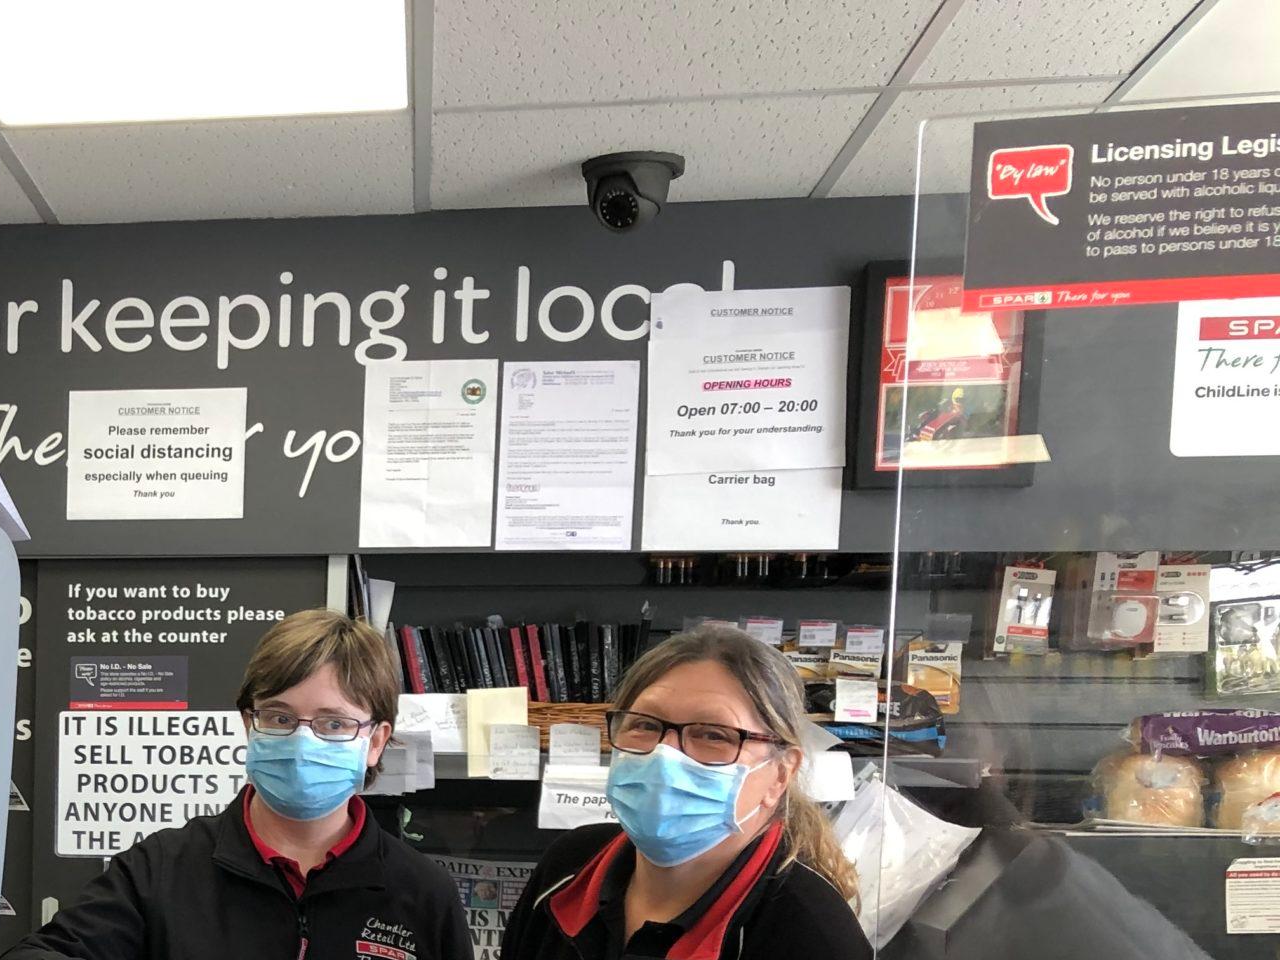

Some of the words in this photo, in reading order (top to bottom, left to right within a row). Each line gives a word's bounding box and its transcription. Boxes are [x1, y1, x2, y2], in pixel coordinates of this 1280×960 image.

[1092, 139, 1213, 163] Licensing
[1090, 176, 1111, 188] No
[1115, 174, 1163, 188] person
[1167, 171, 1206, 183] under
[1089, 191, 1107, 203] be
[1112, 188, 1157, 202] served
[1161, 186, 1189, 198] with
[1194, 183, 1254, 197] alcoholic
[1088, 214, 1111, 226] We
[1115, 212, 1165, 224] reserve
[1169, 210, 1191, 221] the
[1195, 207, 1225, 222] right
[1104, 227, 1153, 240] alcohol
[1169, 226, 1190, 237] we
[1086, 245, 1100, 257] to
[1103, 245, 1137, 259] pass
[1141, 242, 1155, 254] to
[1158, 239, 1215, 255] persons
[1219, 237, 1260, 250] under
[61, 271, 408, 369] keeping
[432, 265, 490, 345] it
[710, 308, 759, 317] CUSTOMER
[761, 307, 794, 316] NOTICE
[703, 353, 757, 364] CUSTOMER
[760, 351, 796, 361] NOTICE
[1198, 347, 1264, 371] There
[703, 380, 751, 390] OPENING
[753, 378, 792, 388] HOURS
[1195, 385, 1270, 398] ChildLine
[118, 407, 166, 415] CUSTOMER
[677, 403, 716, 420] Open
[721, 402, 761, 415] 07:00
[778, 399, 818, 413] 20:00
[108, 425, 146, 435] Please
[150, 425, 210, 435] remember
[83, 444, 135, 459] social
[141, 444, 233, 461] distancing
[85, 471, 142, 483] especially
[146, 471, 177, 481] when
[181, 470, 228, 483] queuing
[708, 474, 750, 486] Carrier
[753, 474, 776, 486] bag
[721, 518, 740, 526] Thank
[68, 584, 82, 598] If
[86, 586, 118, 602] you
[124, 585, 166, 598] want
[173, 585, 191, 598] to
[196, 584, 230, 602] buy
[68, 606, 136, 621] tobacco
[142, 606, 222, 624] products
[227, 606, 285, 624] please
[67, 629, 96, 643] ask
[101, 631, 118, 643] at
[124, 629, 151, 643] the
[158, 630, 227, 643] counter
[833, 652, 880, 664] Panasonic
[911, 652, 959, 664] Panasonic
[64, 717, 86, 736] IT
[96, 717, 118, 736] IS
[129, 717, 234, 736] ILLEGAL
[74, 745, 132, 765] SELL
[77, 774, 218, 794] PRODUCTS
[556, 793, 579, 804] The
[64, 802, 173, 822] ANYONE
[72, 831, 121, 850] THE
[367, 917, 413, 938] Chandler
[361, 928, 395, 945] Retail
[369, 945, 405, 959] SPAR
